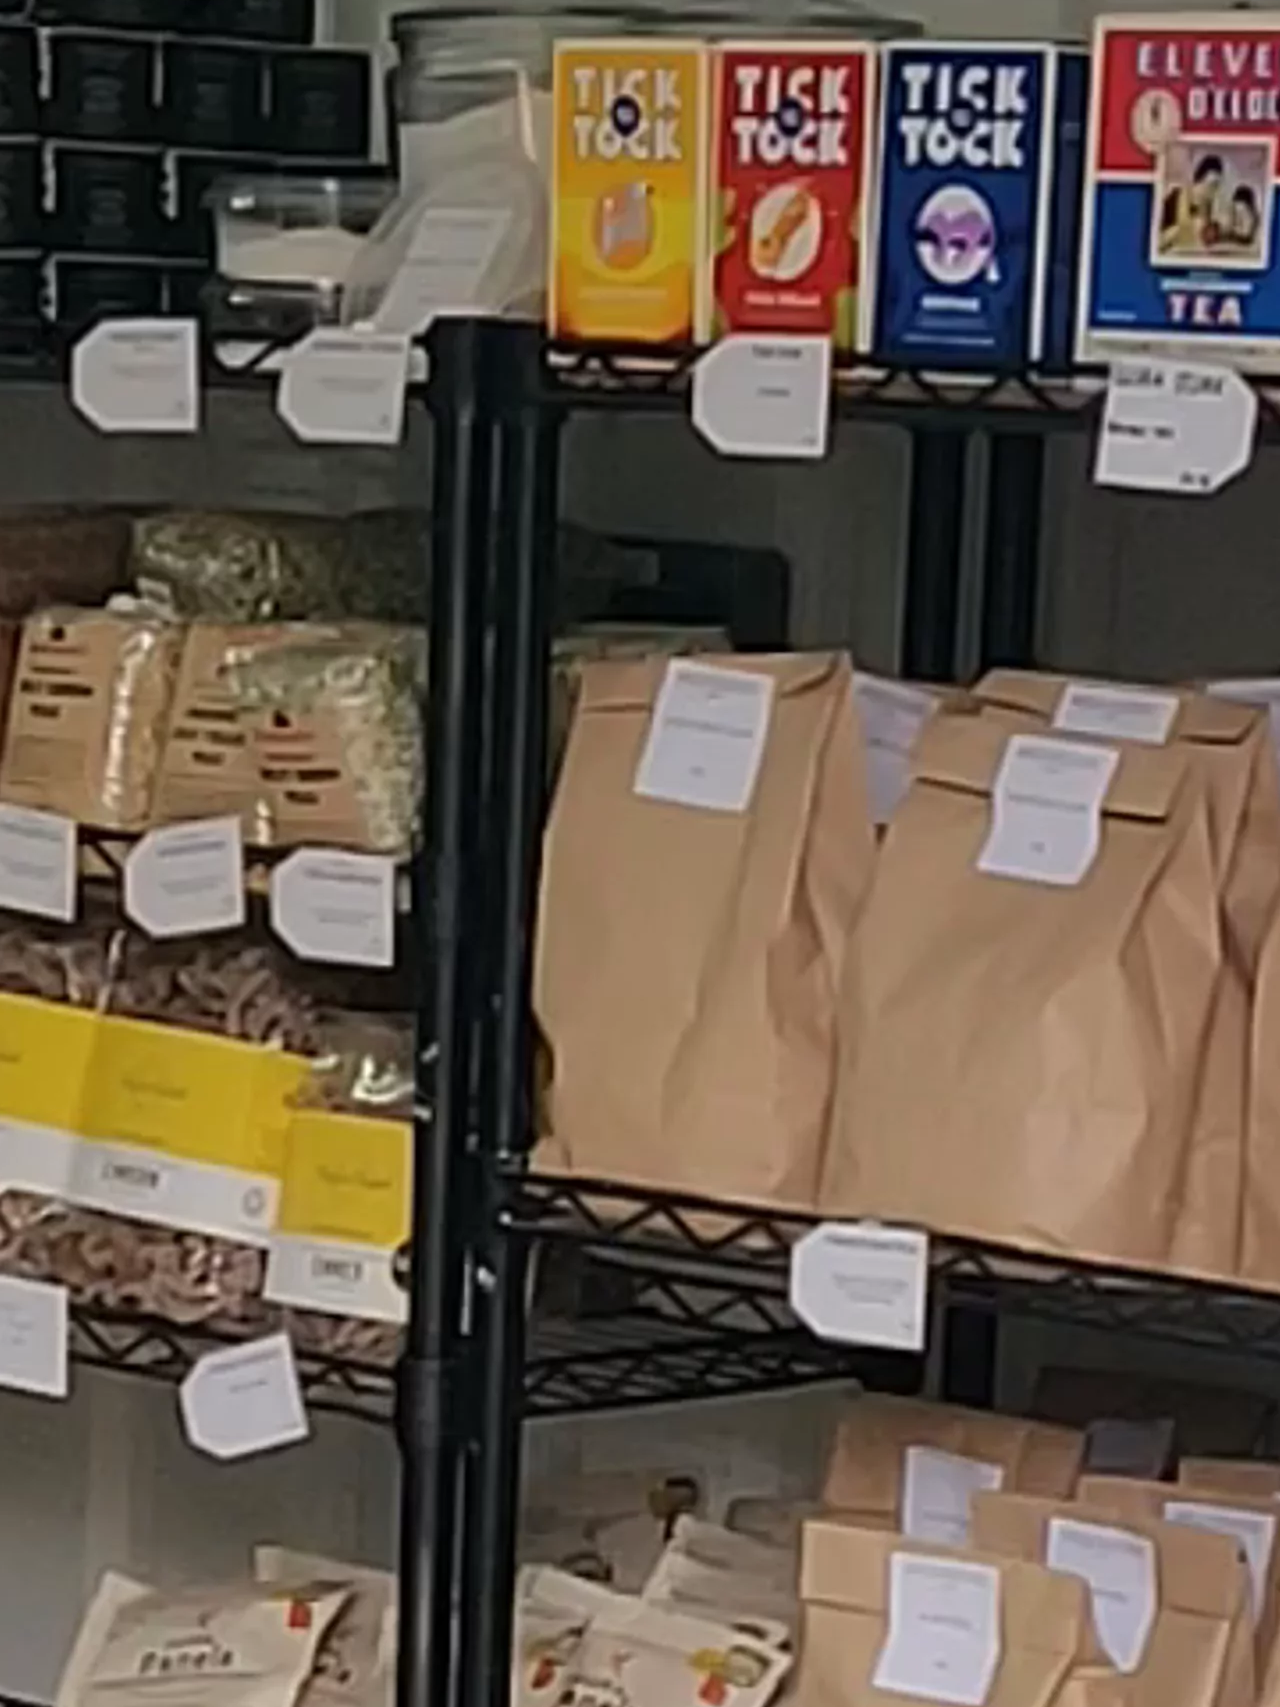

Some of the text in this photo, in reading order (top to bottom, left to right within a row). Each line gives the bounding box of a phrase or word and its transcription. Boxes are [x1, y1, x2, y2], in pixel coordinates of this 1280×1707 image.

[572, 67, 683, 112] TICK
[734, 65, 850, 114] TICK
[901, 62, 1028, 114] TICK
[572, 114, 684, 161] TOCK
[731, 116, 848, 167] TOCK
[898, 115, 1024, 169] TOCK
[1169, 293, 1243, 326] TEA
